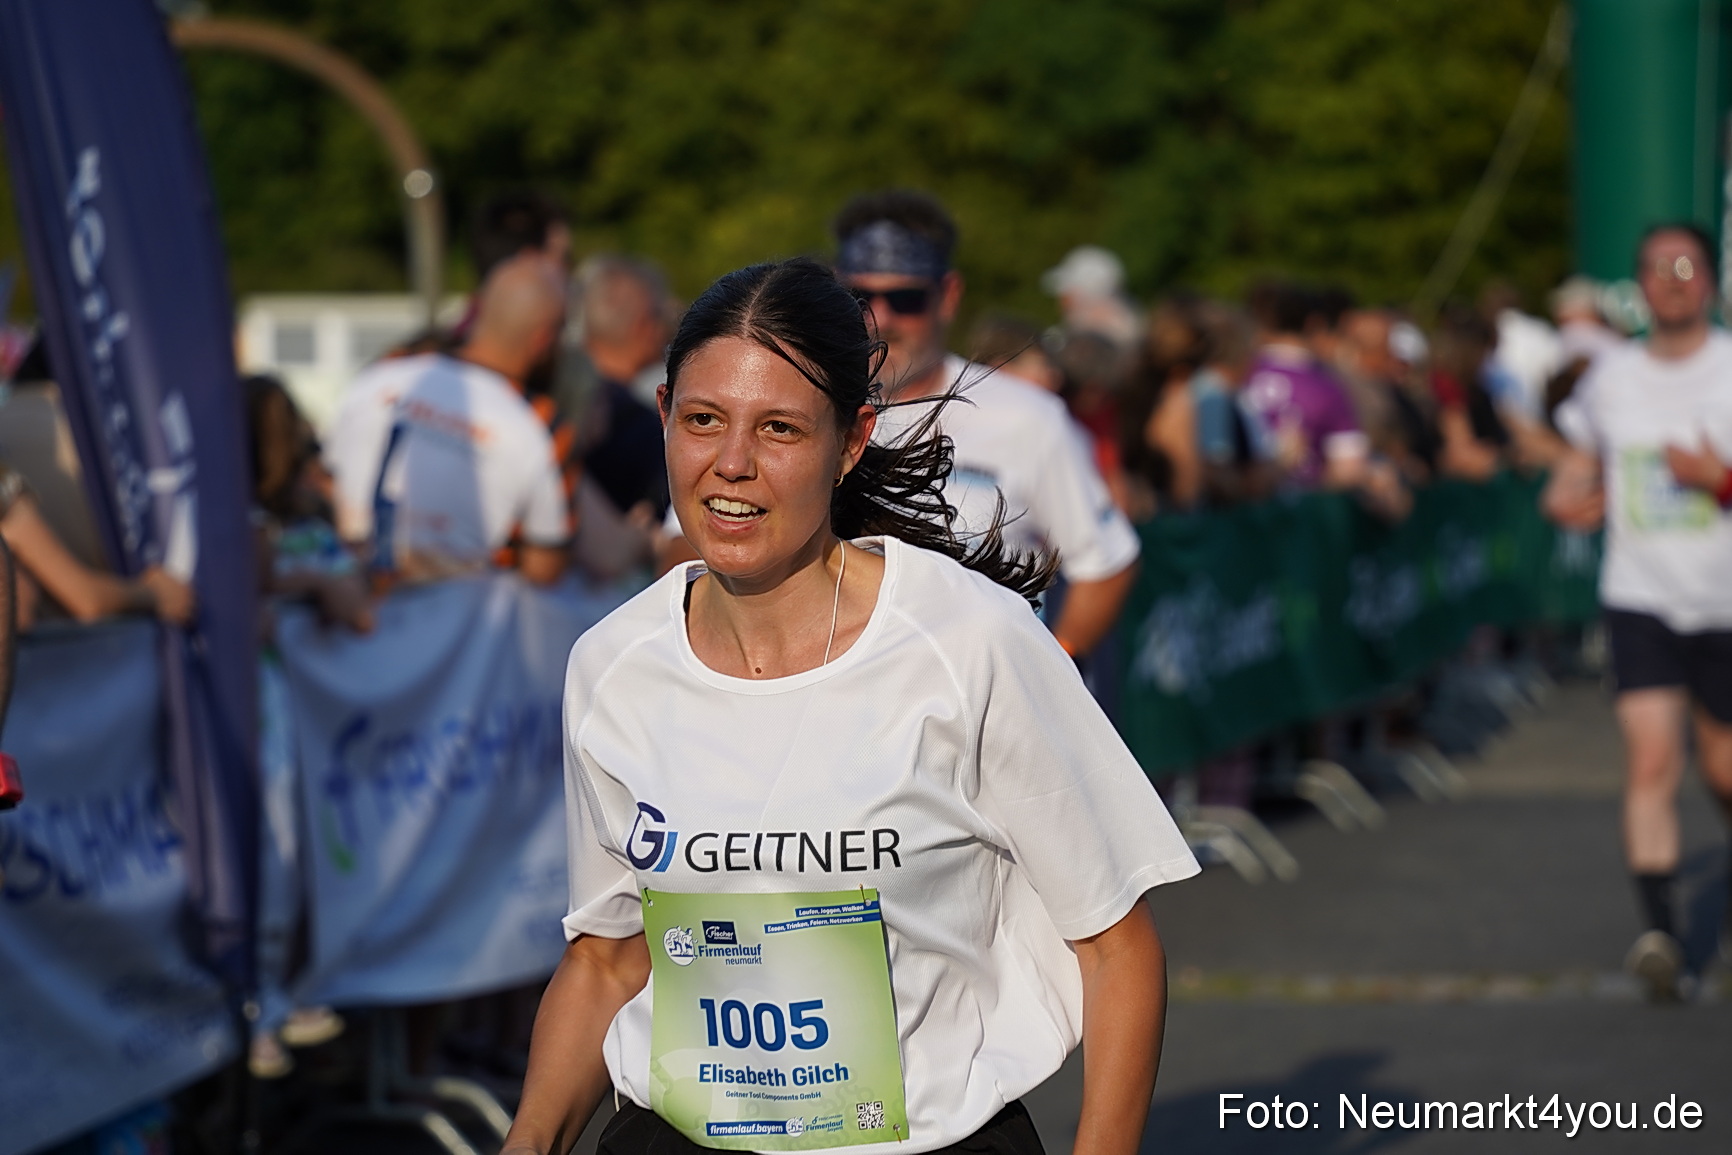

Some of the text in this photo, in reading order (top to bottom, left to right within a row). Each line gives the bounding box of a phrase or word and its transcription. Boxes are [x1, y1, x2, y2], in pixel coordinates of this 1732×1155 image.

[685, 828, 901, 873] GEITNER
[799, 908, 820, 916] Laufen,
[842, 904, 864, 912] Walken
[767, 916, 863, 932] Essen, Trinken, Feiern, Netzwerken
[706, 925, 734, 938] Fischer
[698, 944, 762, 957] Firmenlauf
[725, 956, 763, 966] neumarkt
[699, 998, 829, 1052] 1005
[698, 1062, 849, 1087] Elisabeth Gilch
[725, 1090, 821, 1102] Geitner Tool Components GmbH
[710, 1123, 783, 1135] firmenlauf.bayern
[805, 1119, 843, 1131] Firmenlauf
